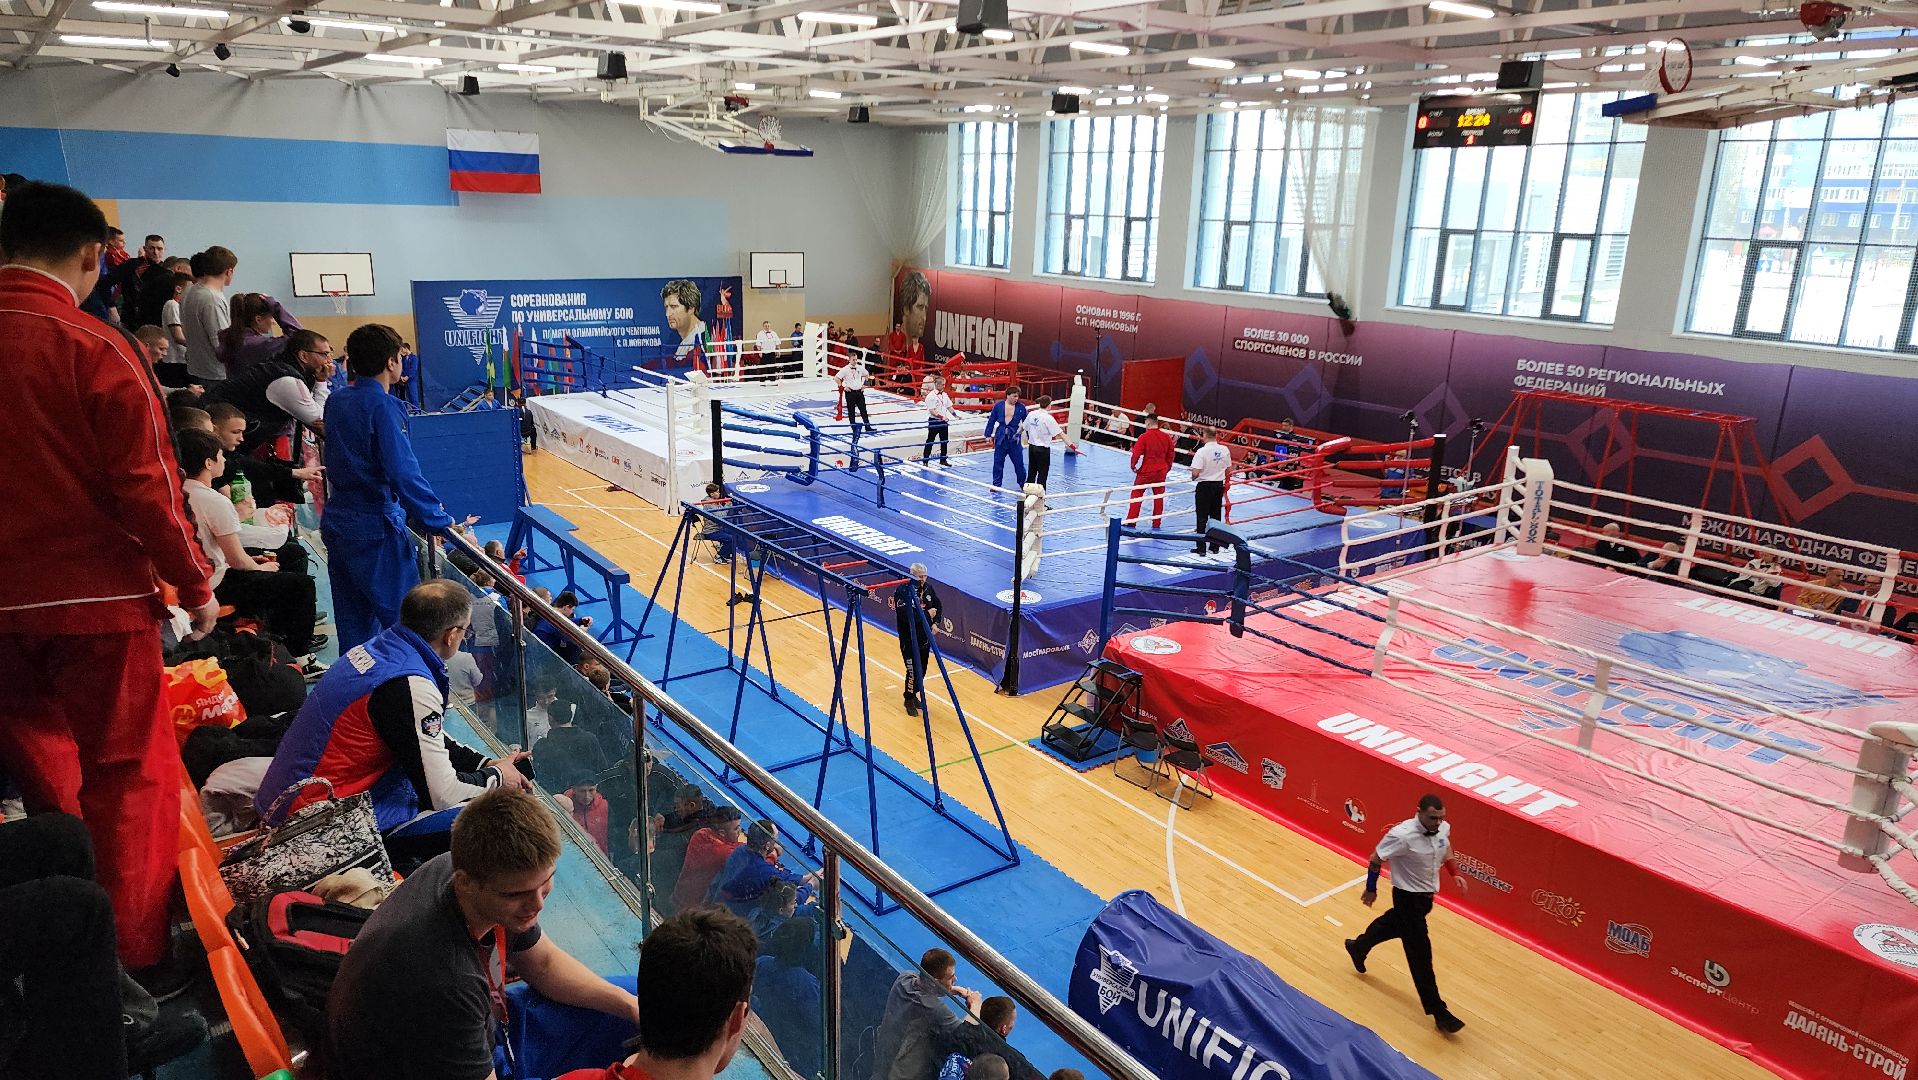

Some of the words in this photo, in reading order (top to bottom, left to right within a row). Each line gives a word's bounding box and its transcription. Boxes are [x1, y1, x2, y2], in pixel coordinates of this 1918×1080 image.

[511, 292, 586, 308] СОРЕВНОВАНИЯ
[512, 310, 524, 323] ПО
[527, 308, 612, 323] УНИВЕРСАЛЬНОМУ
[615, 307, 633, 320] БОЮ
[1076, 305, 1111, 318] ОСНОВАН
[1112, 310, 1119, 318] В
[1119, 310, 1135, 321] 1996
[626, 325, 661, 337] ЧЕМПИОНА
[1090, 318, 1139, 333] НОВИКОВЫМ
[935, 310, 1023, 362] UNIFIGHT
[1243, 327, 1275, 342] БОЛЕЕ
[1277, 331, 1289, 343] 30
[1289, 333, 1310, 345] 000
[1234, 340, 1306, 359] СПОРТСМЕНОВ
[1308, 350, 1316, 360] В
[1317, 351, 1363, 366] РОССИИ
[1514, 375, 1607, 398] ФЕДЕРАЦИЙ
[1516, 359, 1564, 376] БОЛЕЕ
[1566, 365, 1585, 379] 50
[1588, 367, 1726, 396] РЕГИОНАЛЬНЫХ
[811, 515, 926, 556] UNIFIGHT
[1316, 712, 1580, 817] UNIFIGHT
[1099, 985, 1121, 1003] БОЙ
[1782, 1010, 1908, 1080] ДАЛЯНЬ-СТРОЙ
